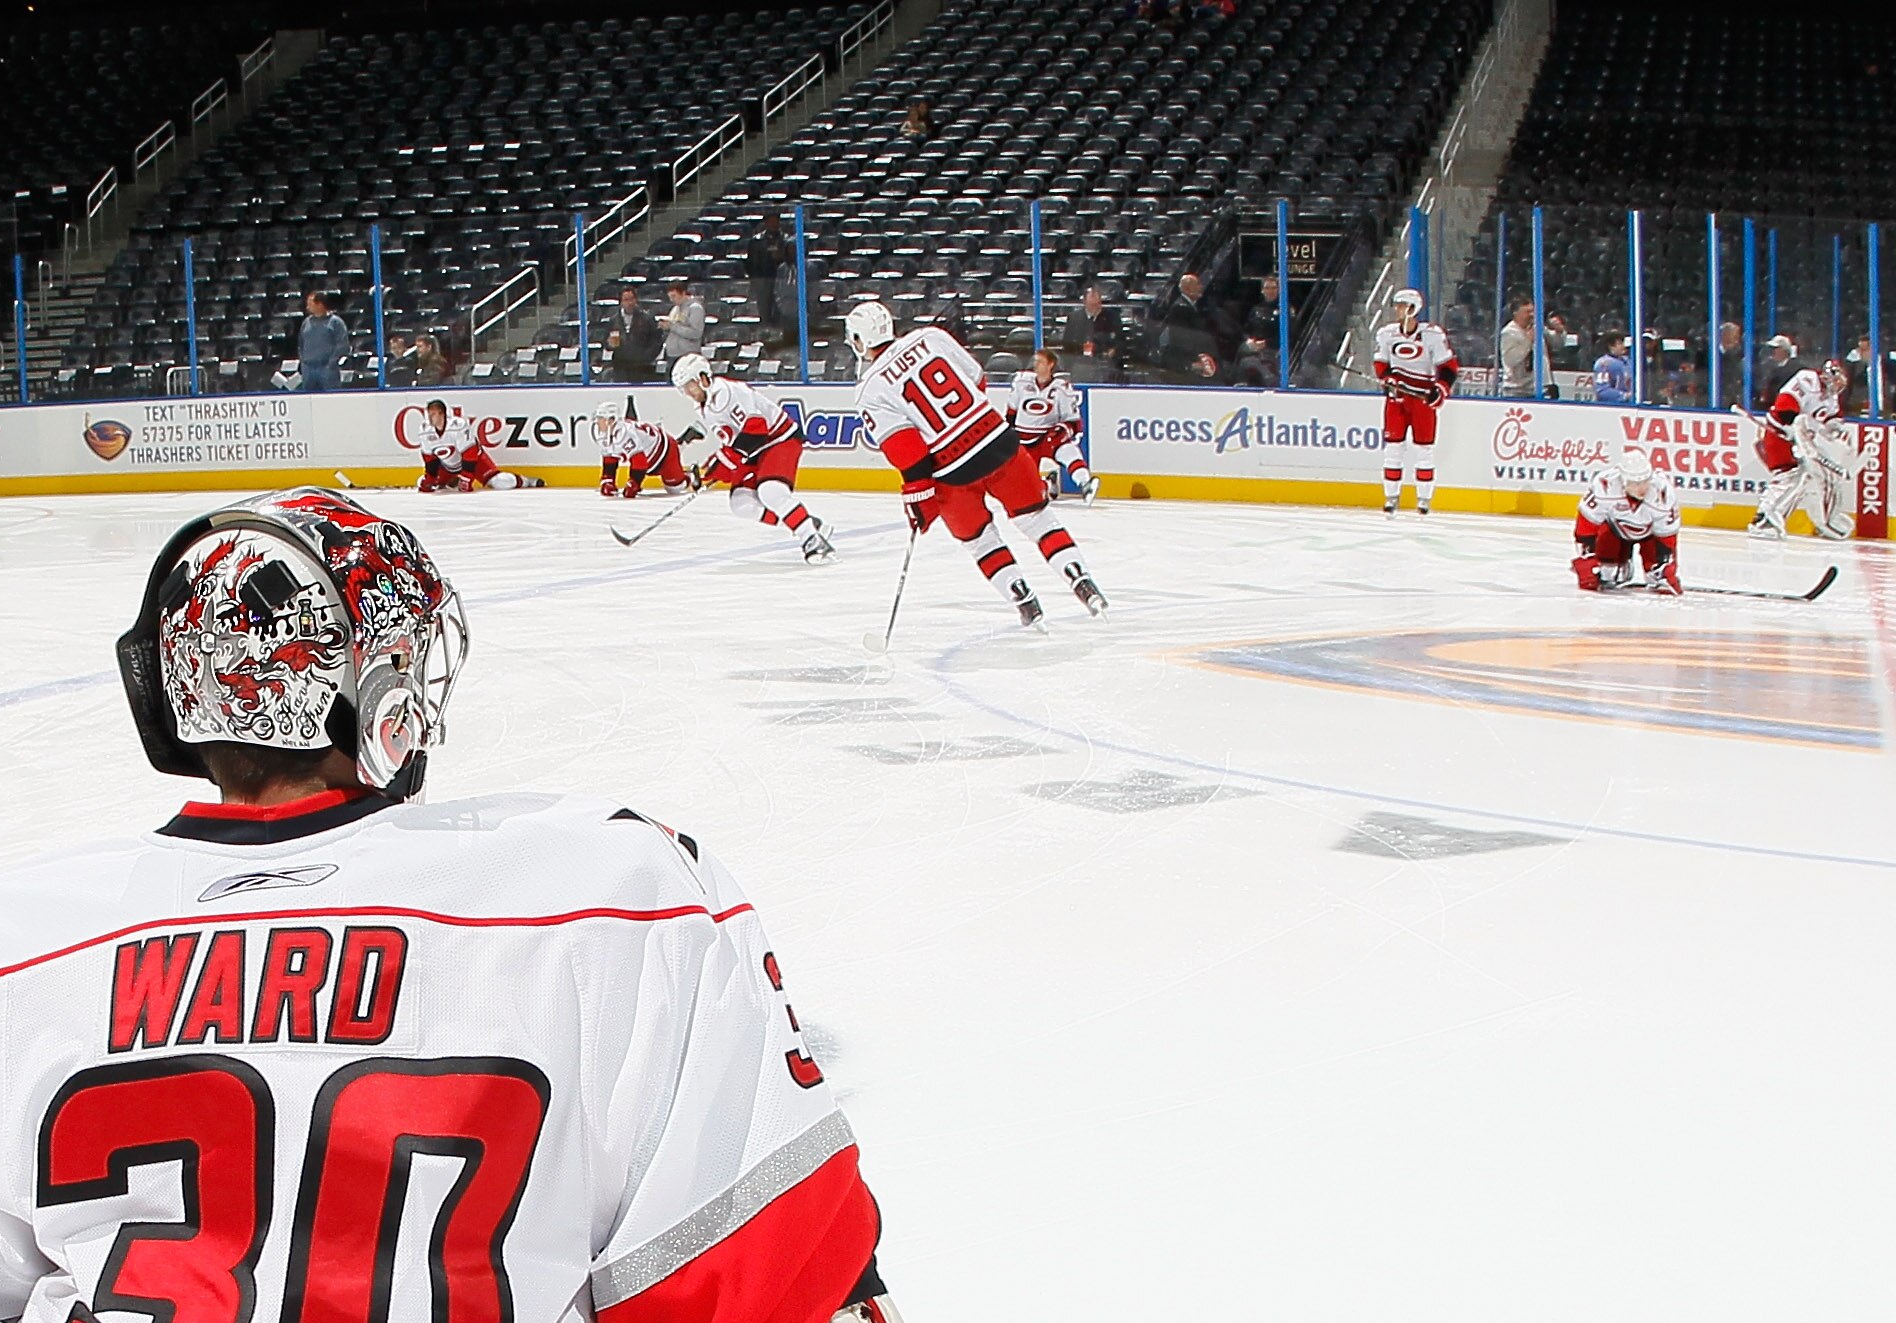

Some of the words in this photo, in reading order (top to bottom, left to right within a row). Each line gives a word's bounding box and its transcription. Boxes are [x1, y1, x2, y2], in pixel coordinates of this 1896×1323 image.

[1273, 240, 1316, 258] lvel
[880, 339, 933, 385] TLUSTY
[902, 356, 974, 434] 19
[144, 404, 175, 422] TEXT
[179, 400, 266, 421] "THRASHTIX"
[270, 400, 287, 417] TO
[731, 406, 746, 427] 15
[142, 424, 184, 442] 57375
[188, 424, 211, 441] FOR
[216, 423, 240, 440] THE
[246, 420, 292, 439] LATEST
[1116, 405, 1385, 454] accessAtlanta.co
[1621, 416, 1739, 447] VALUE
[129, 446, 202, 464] THRASHERS
[207, 443, 251, 461] TICKET
[255, 442, 309, 460] OFFERS!
[1494, 466, 1546, 480] VISIT
[1861, 426, 1884, 515] Reebok
[107, 924, 410, 1054] WARD
